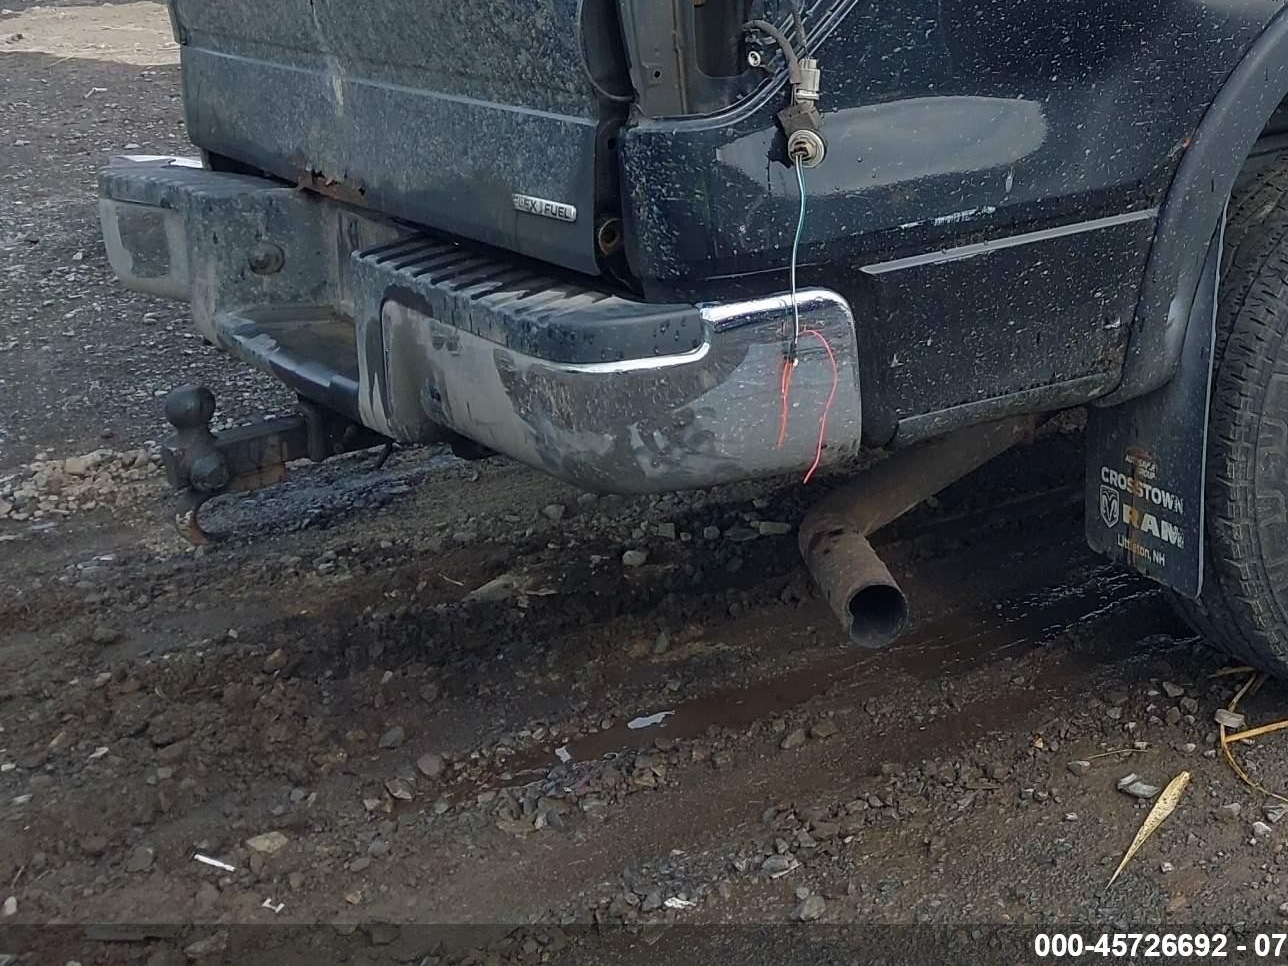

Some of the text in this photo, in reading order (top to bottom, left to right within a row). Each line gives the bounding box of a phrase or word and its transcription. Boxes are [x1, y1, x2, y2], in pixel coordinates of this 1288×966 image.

[544, 203, 572, 219] FUEL
[1101, 466, 1183, 514] CROSSTOWN
[1152, 549, 1166, 567] NH
